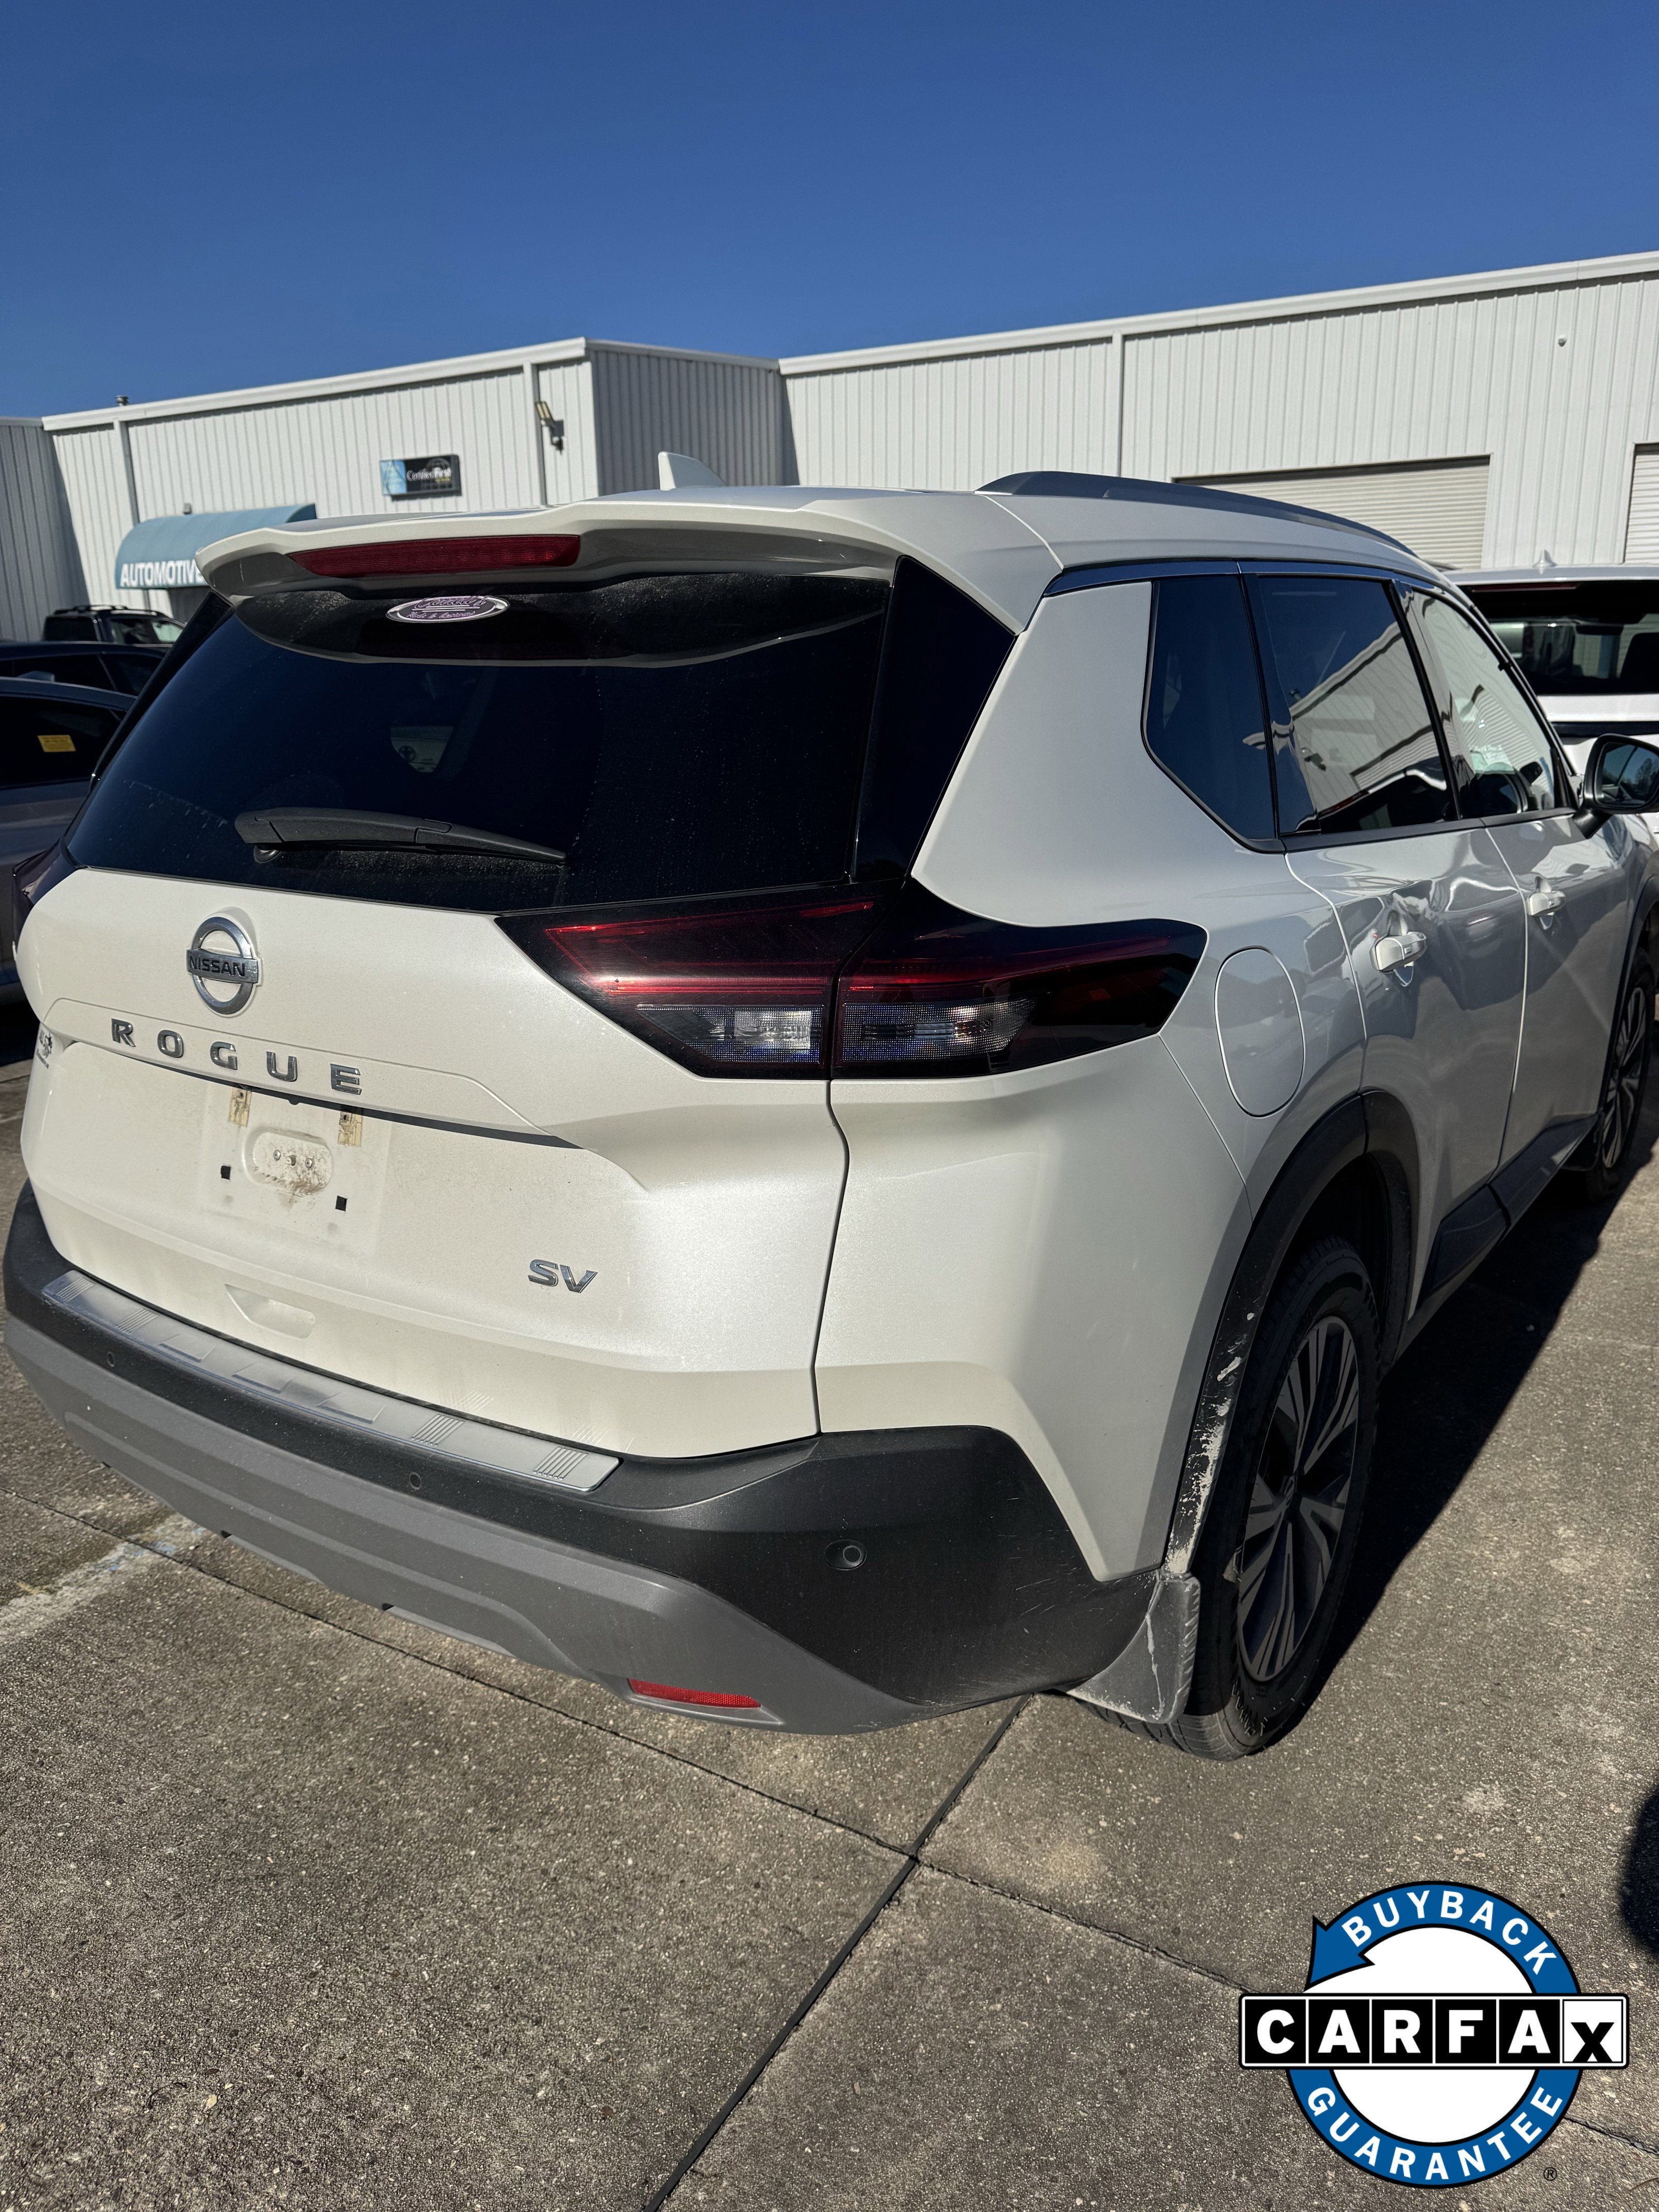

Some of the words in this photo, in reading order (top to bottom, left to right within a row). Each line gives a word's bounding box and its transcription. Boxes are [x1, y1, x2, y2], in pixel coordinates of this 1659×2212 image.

[189, 955, 246, 977] NISSAN
[111, 1018, 362, 1095] ROGUE
[527, 1259, 599, 1294] SV
